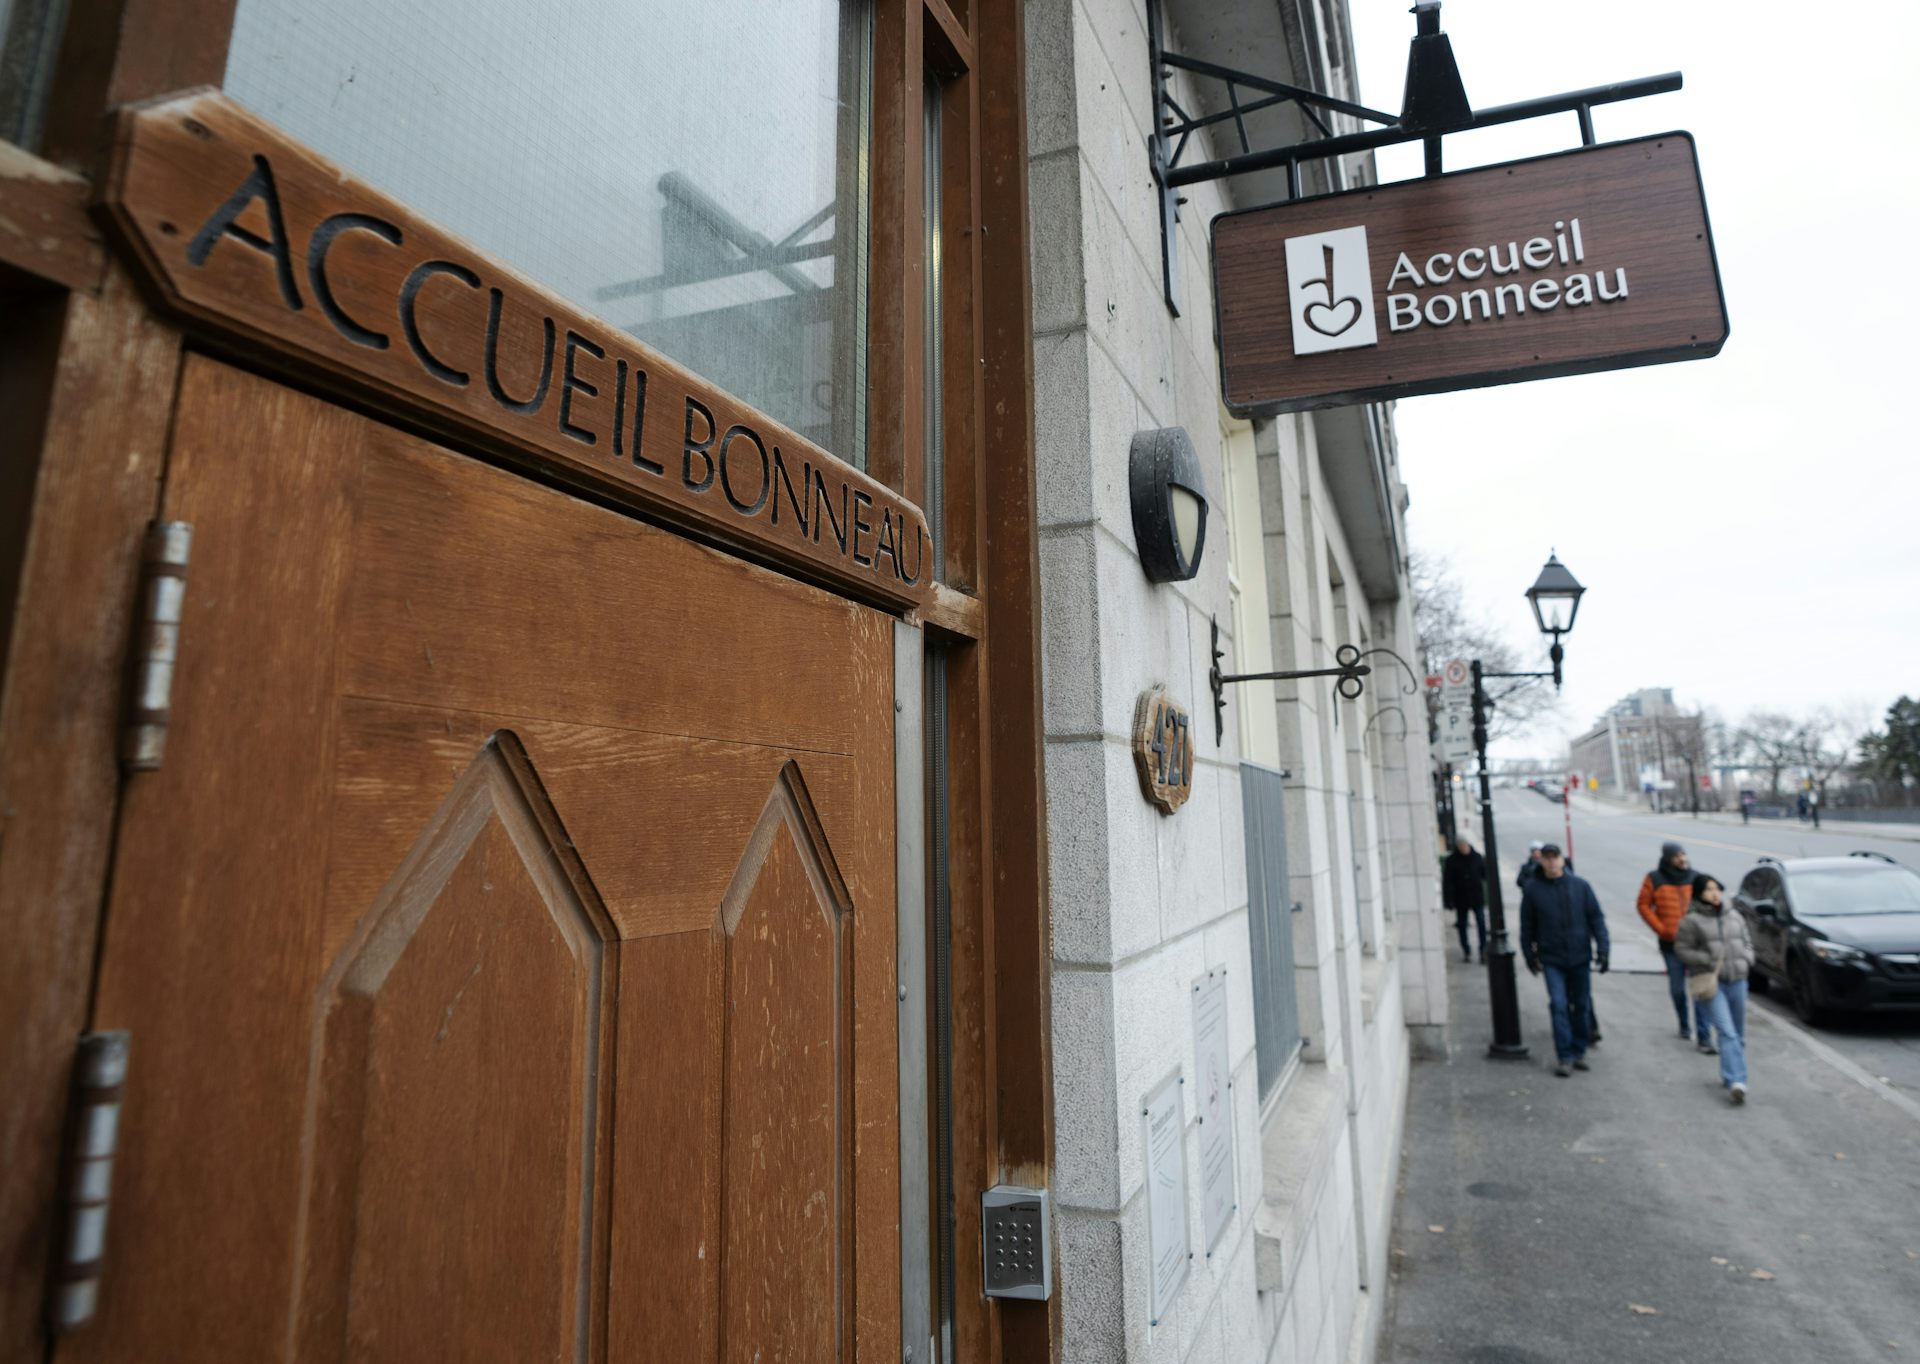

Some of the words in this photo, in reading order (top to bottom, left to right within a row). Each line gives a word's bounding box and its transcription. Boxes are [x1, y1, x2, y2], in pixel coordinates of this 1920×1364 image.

[1387, 218, 1585, 291] Accueil
[1387, 266, 1630, 333] Bonneau
[186, 153, 664, 476] ACCUEIL
[682, 396, 923, 586] BONNEAU
[1151, 703, 1188, 787] 427
